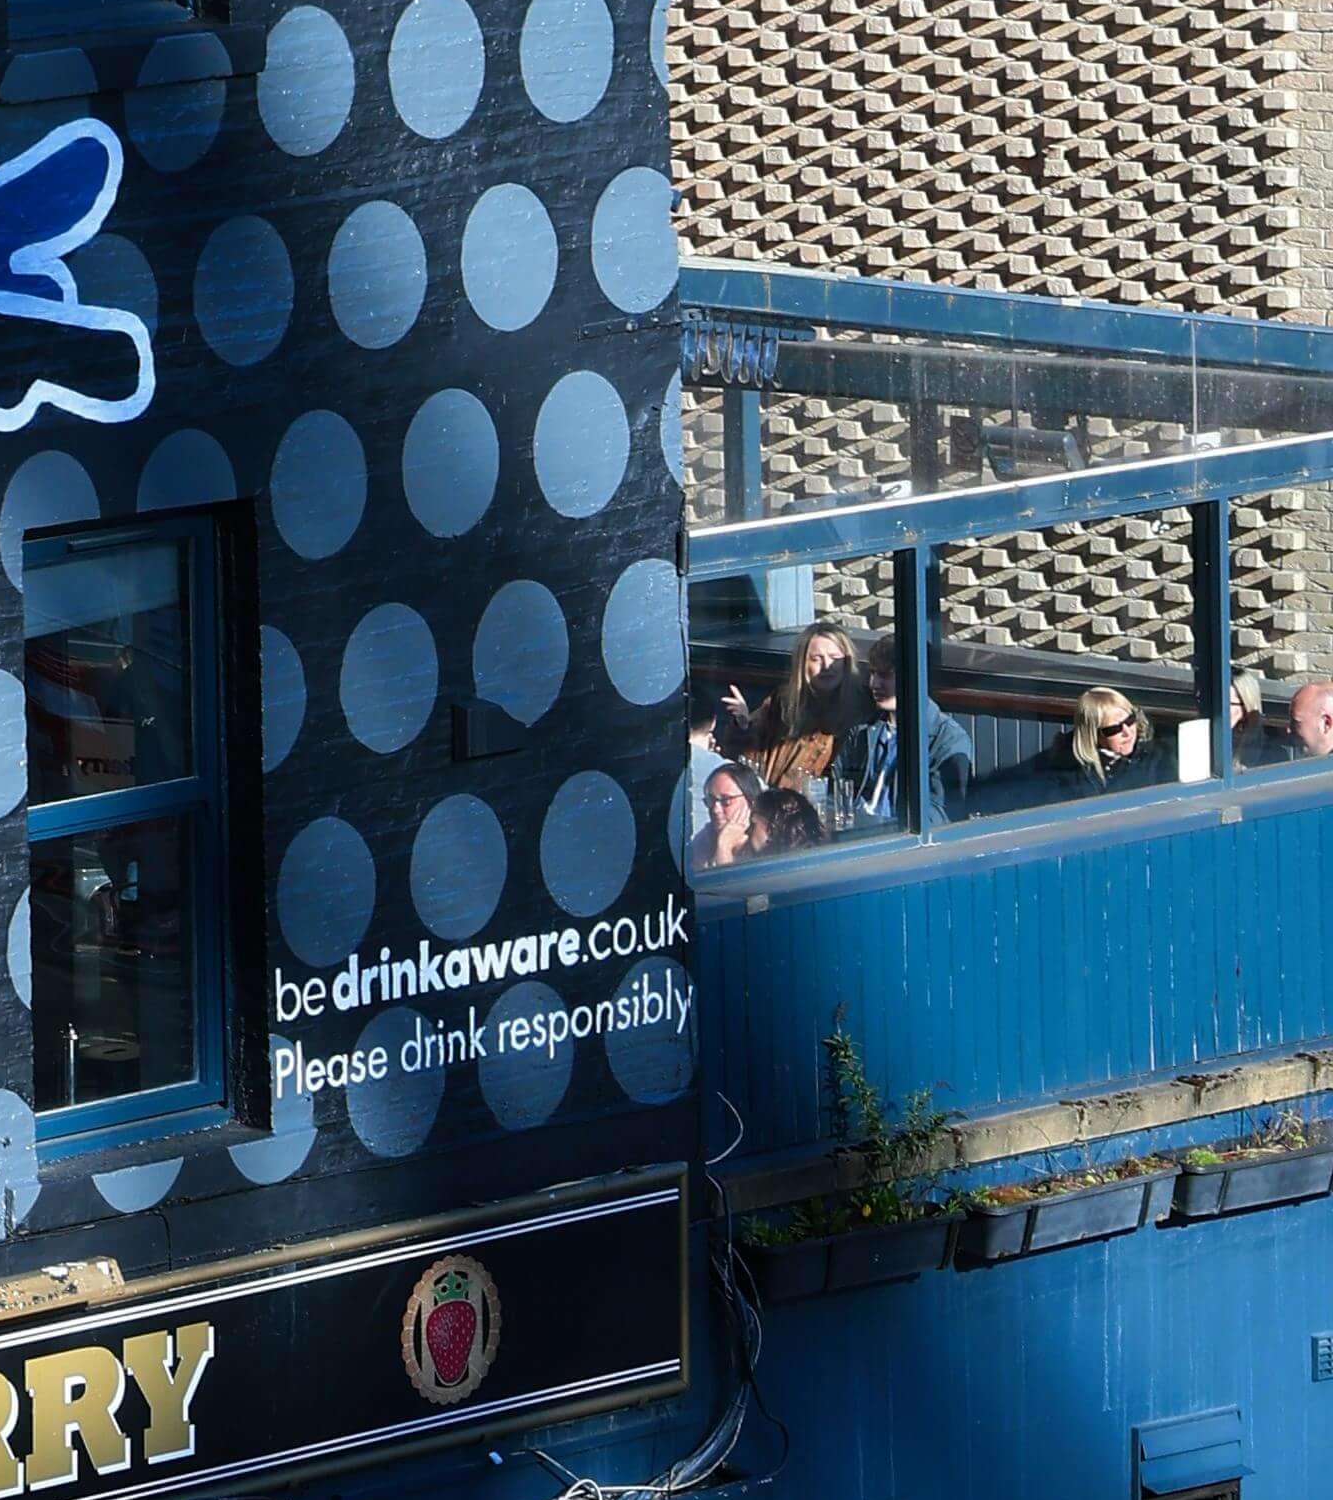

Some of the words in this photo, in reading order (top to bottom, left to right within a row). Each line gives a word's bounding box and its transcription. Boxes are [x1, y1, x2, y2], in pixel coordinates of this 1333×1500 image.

[275, 967, 326, 1022] be
[332, 893, 689, 1011] drinkaware.co.uk
[275, 1041, 387, 1099] Please
[401, 1006, 486, 1073] drink
[498, 968, 693, 1059] responsibly
